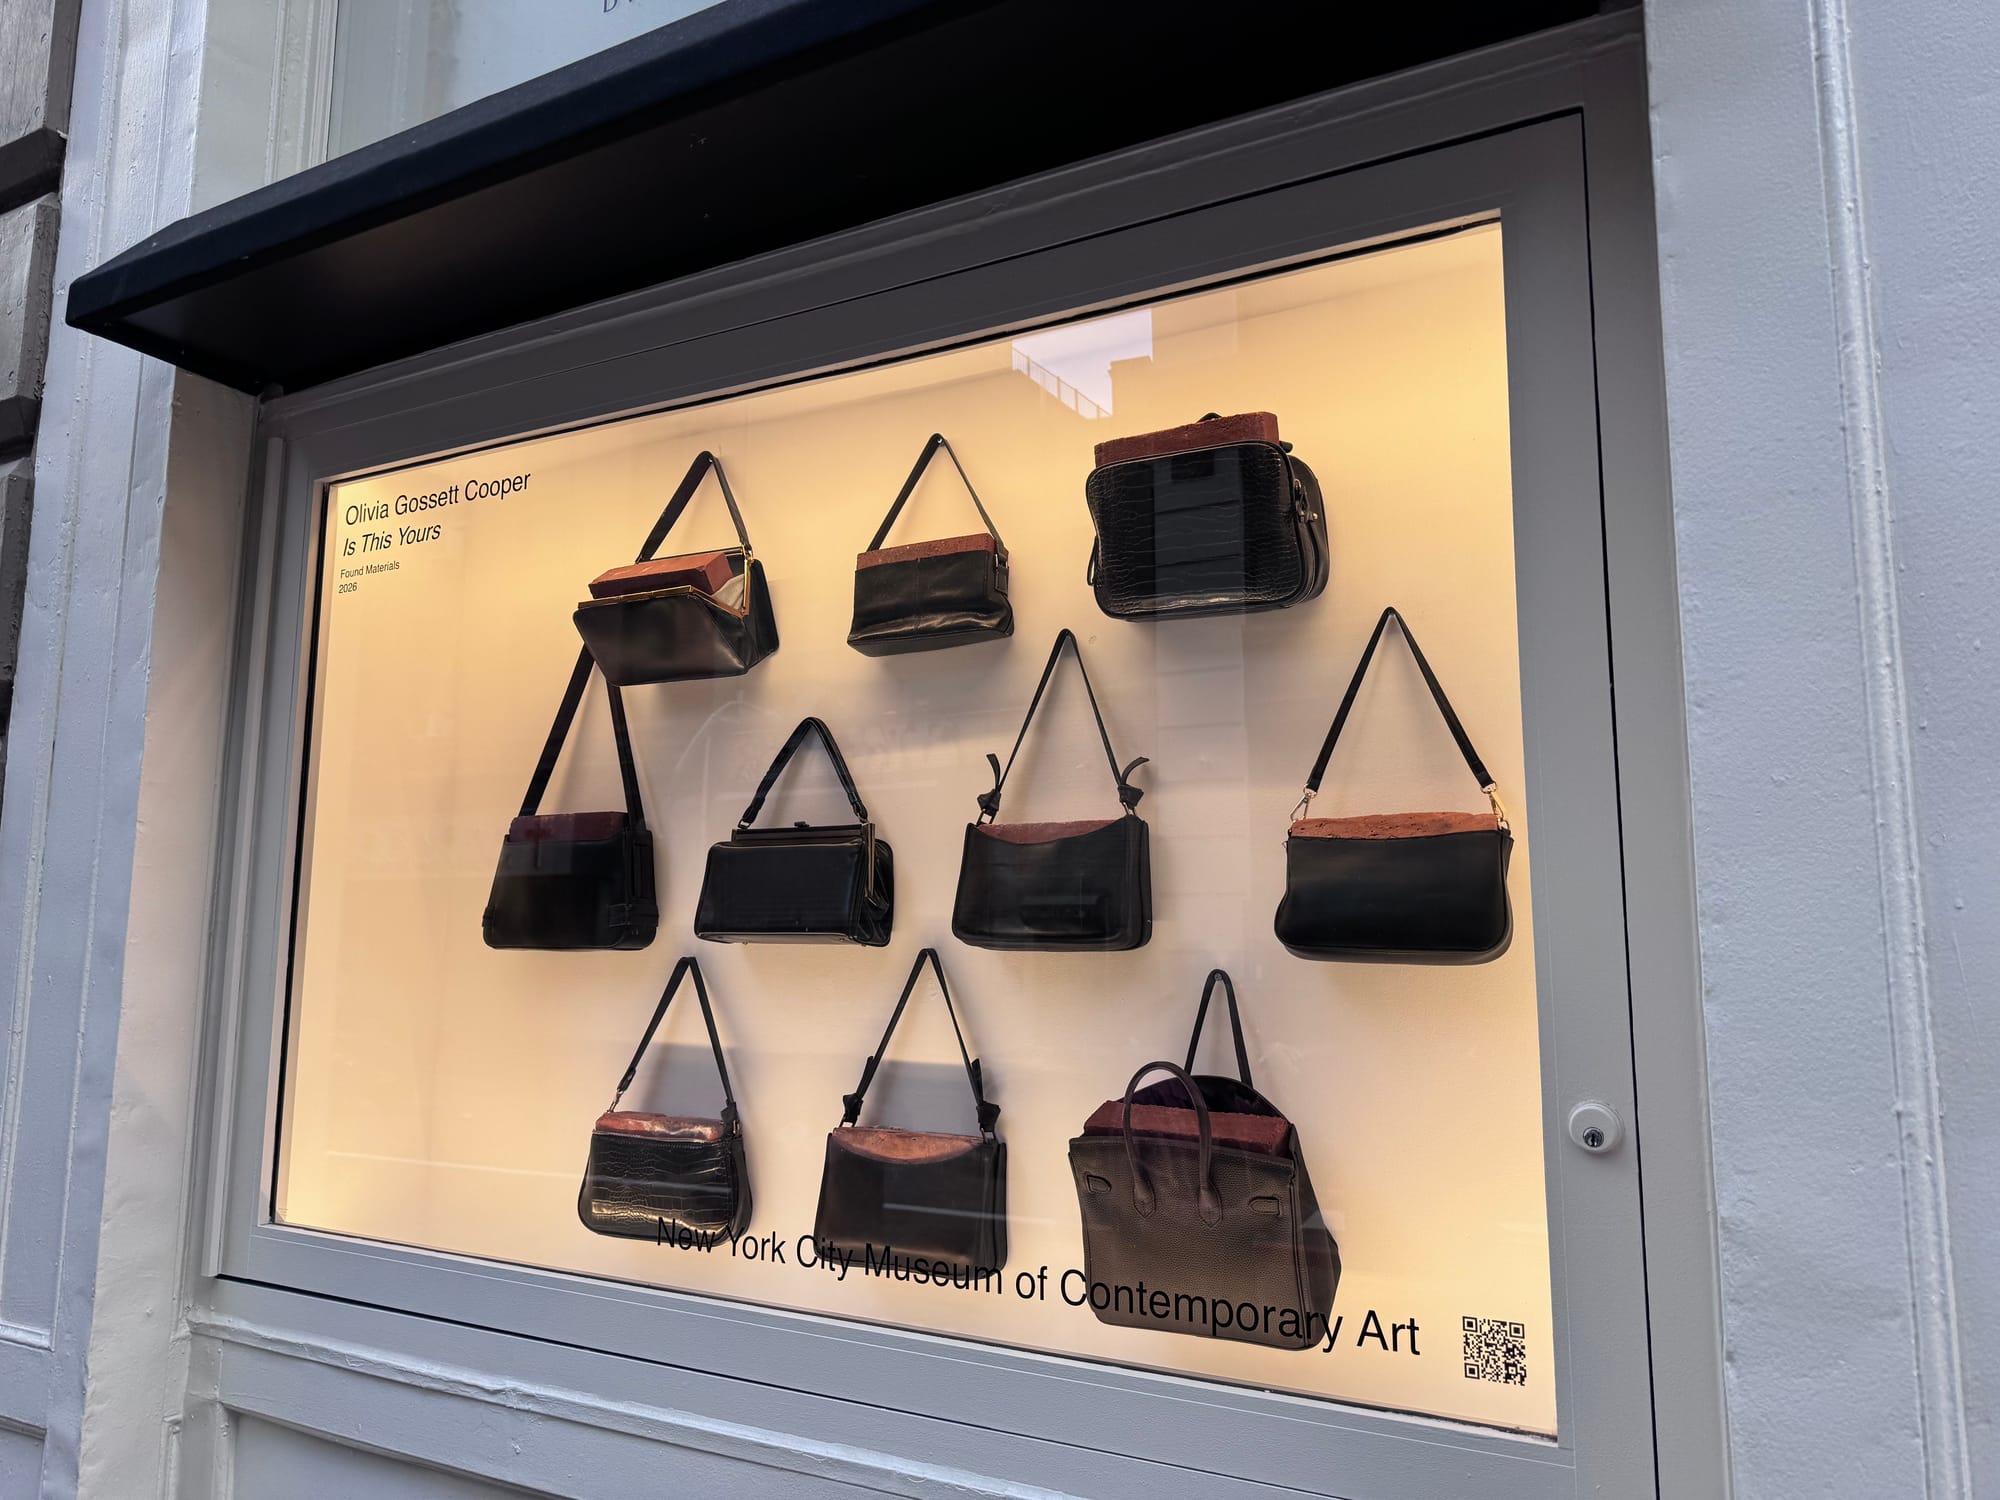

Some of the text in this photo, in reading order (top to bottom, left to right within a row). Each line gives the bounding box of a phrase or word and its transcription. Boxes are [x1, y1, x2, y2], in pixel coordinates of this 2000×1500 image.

[345, 473, 531, 526] Olivia Gossett Cooper
[343, 524, 442, 557] Is This Yours
[340, 560, 400, 579] Found Materials
[338, 582, 358, 594] 2026
[656, 1216, 1421, 1356] New York City Museum of Contemporary Art
